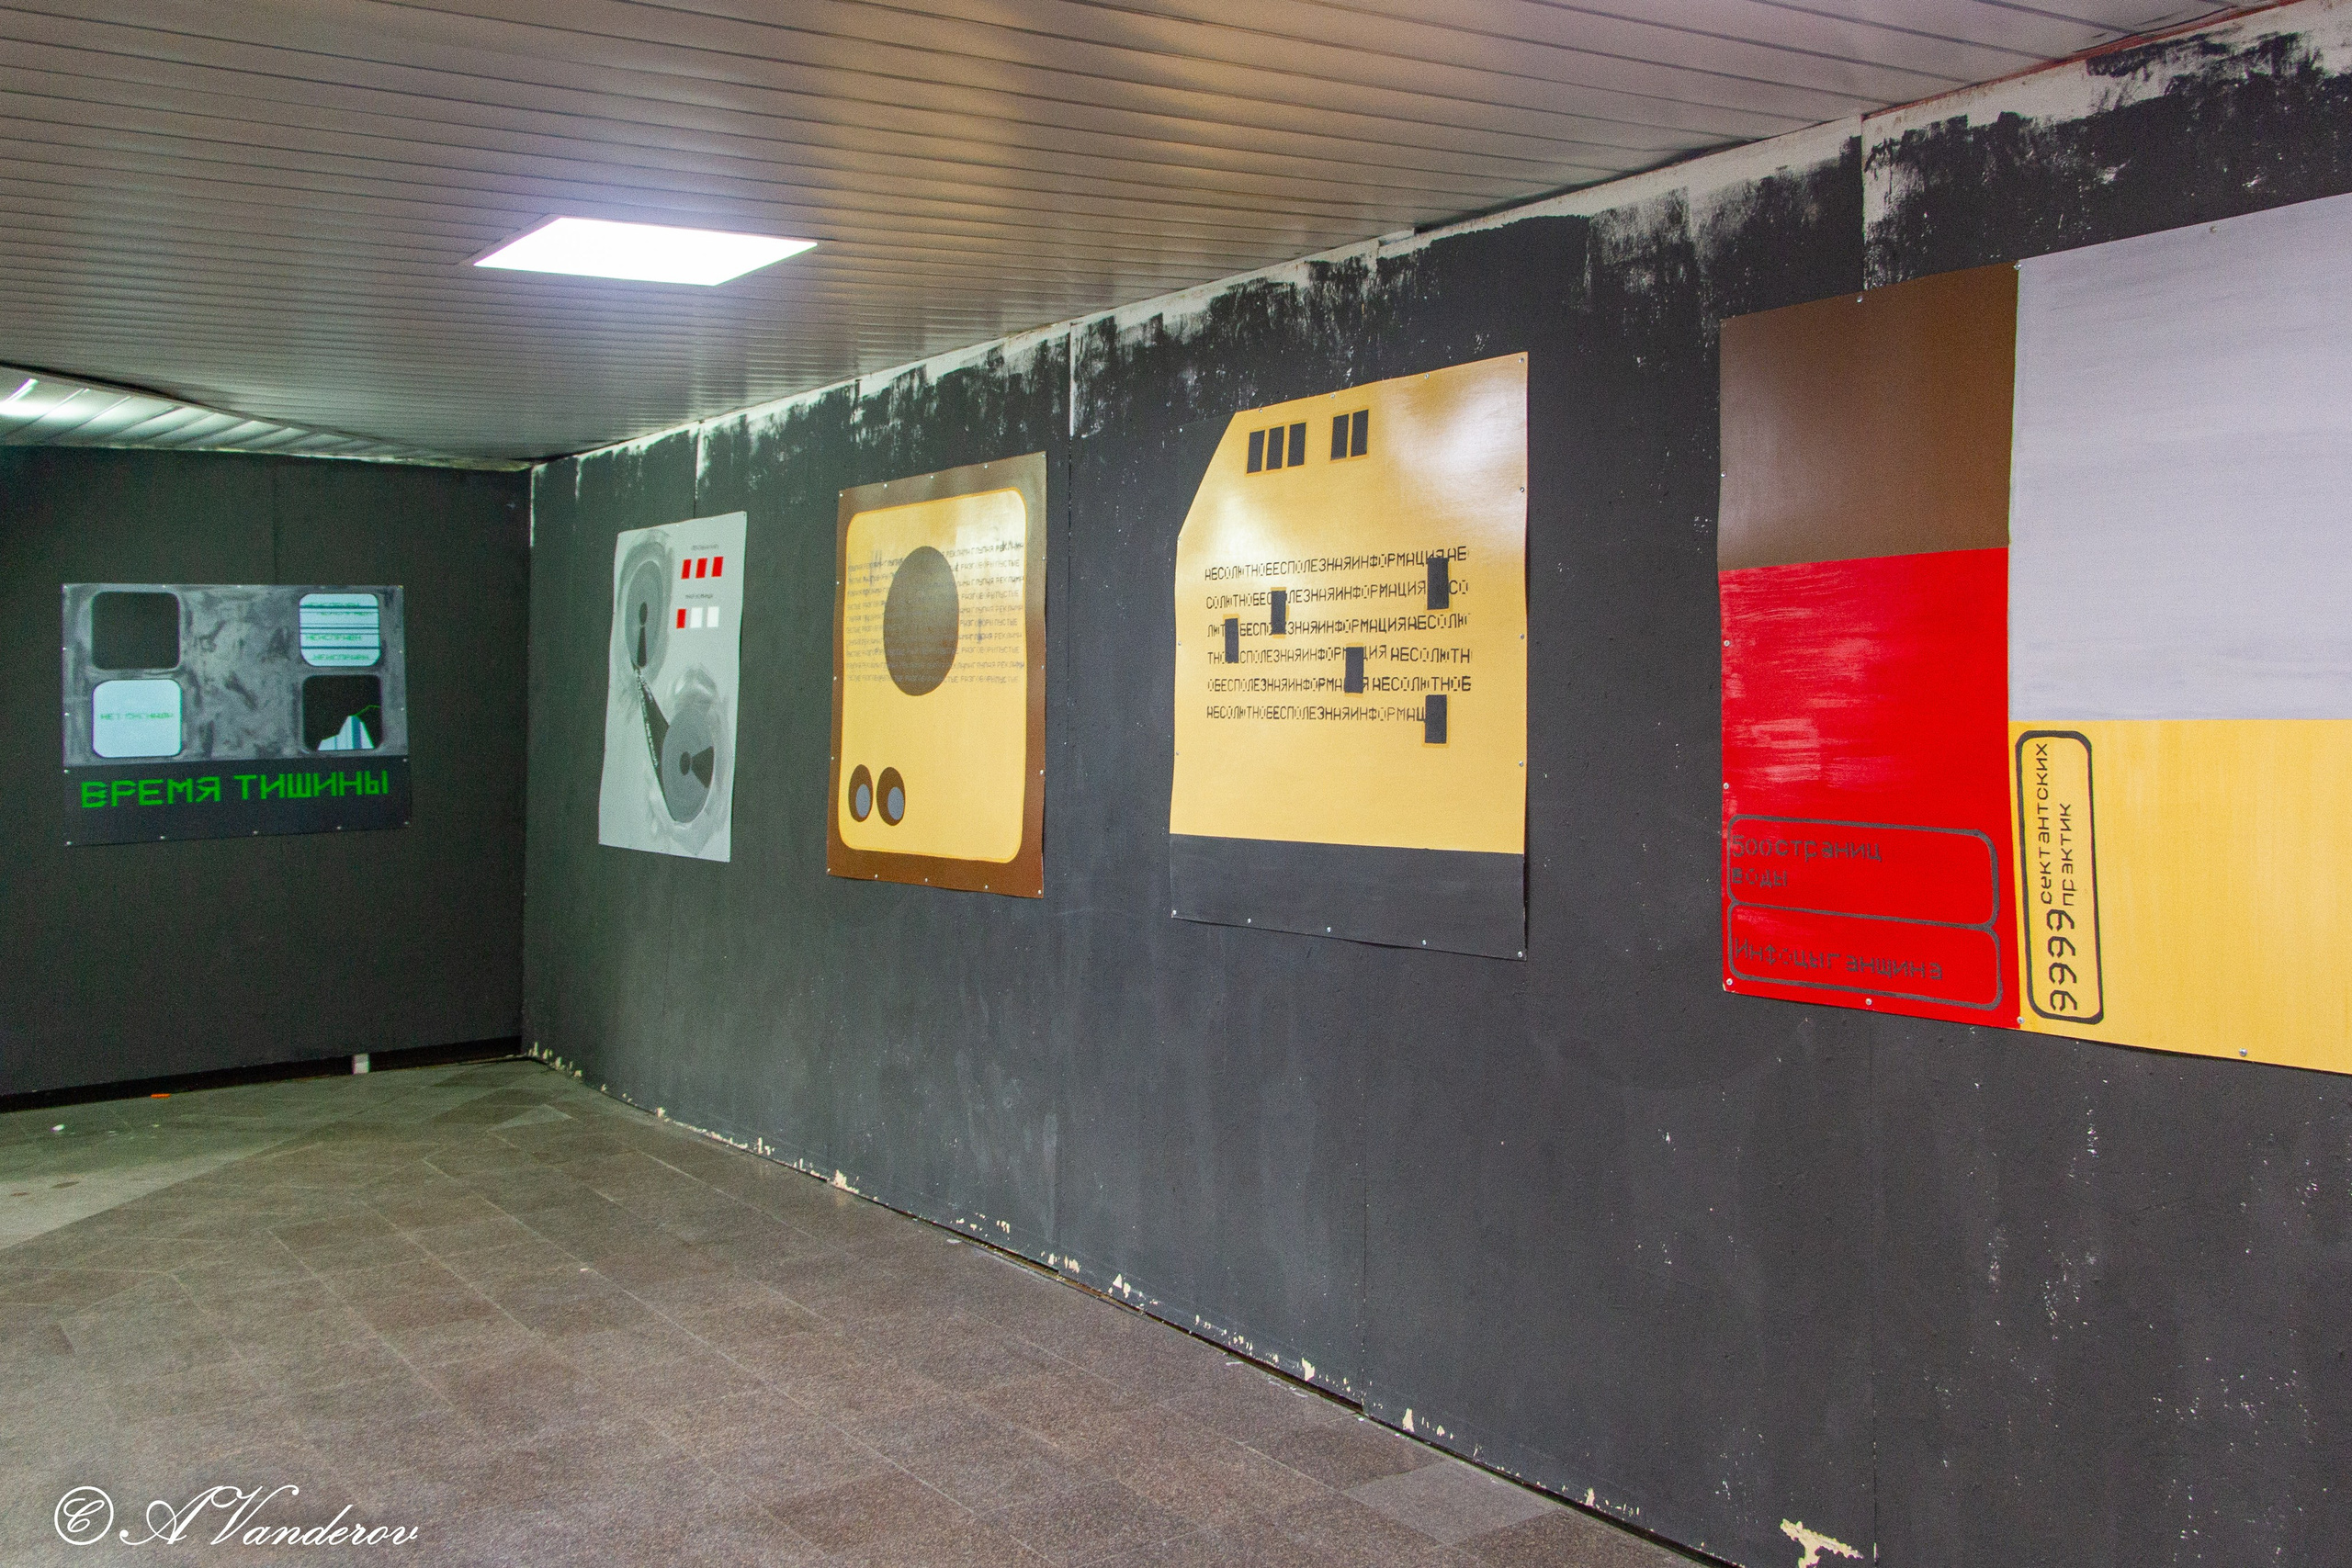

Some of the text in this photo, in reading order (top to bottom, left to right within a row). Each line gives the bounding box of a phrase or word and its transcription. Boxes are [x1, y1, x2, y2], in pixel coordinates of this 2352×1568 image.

[233, 770, 388, 800] ТИШИНЫ
[2059, 803, 2075, 906] практик
[2046, 908, 2077, 1011] 9999
